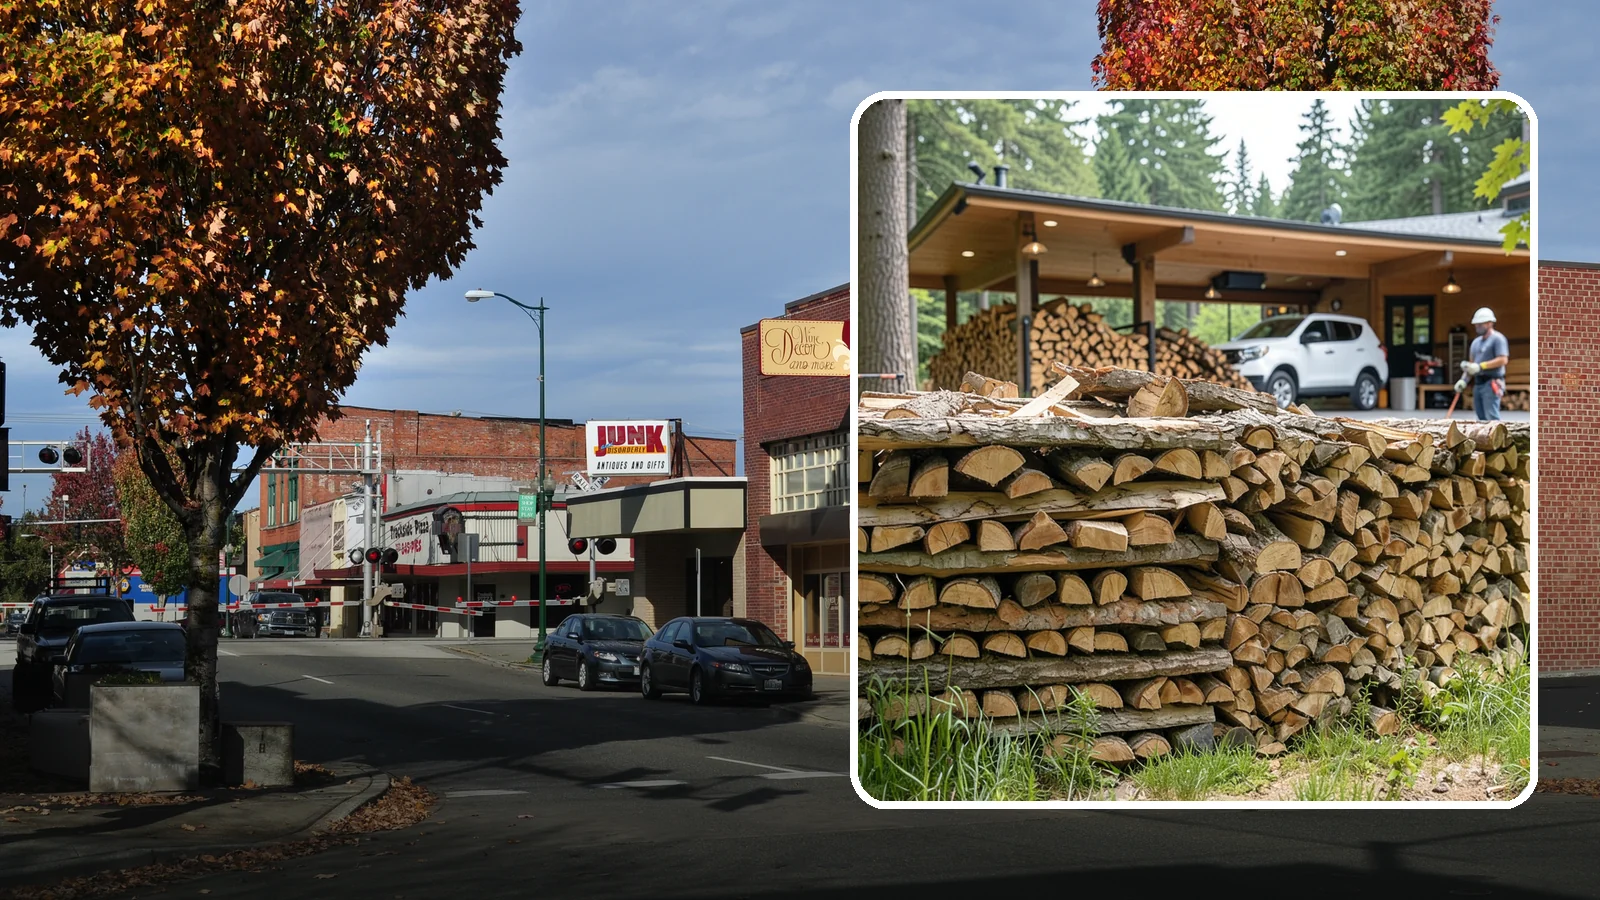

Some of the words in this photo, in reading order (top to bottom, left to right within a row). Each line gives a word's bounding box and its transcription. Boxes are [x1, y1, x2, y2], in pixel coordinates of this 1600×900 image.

[596, 425, 665, 457] JUNK
[607, 446, 646, 454] DISORDERLY
[597, 461, 628, 470] ANTIQUES
[631, 461, 644, 470] AND
[647, 460, 665, 470] GIFTS
[589, 476, 608, 491] SING
[390, 521, 413, 539] Trackside
[414, 519, 429, 535] Pizza
